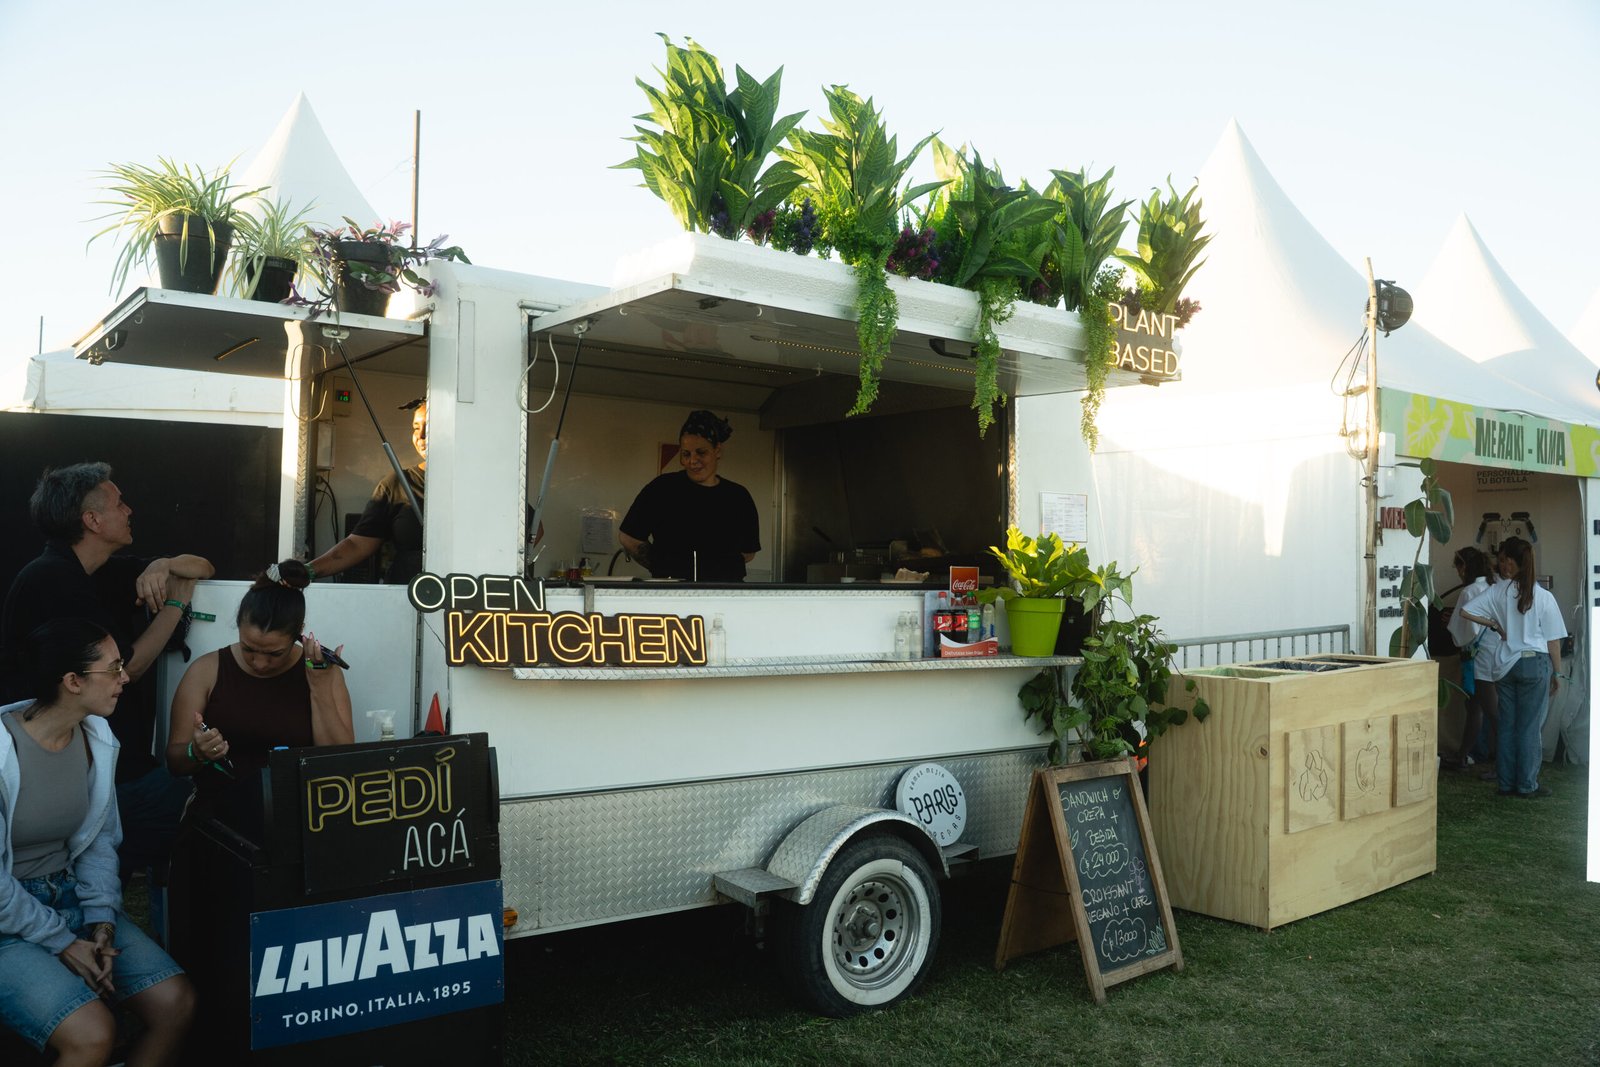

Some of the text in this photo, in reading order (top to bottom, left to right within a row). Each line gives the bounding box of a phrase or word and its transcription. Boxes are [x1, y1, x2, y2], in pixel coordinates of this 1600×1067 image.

[1106, 302, 1180, 339] PLANT
[1105, 341, 1179, 375] BASED
[1475, 417, 1524, 462] MERAKI
[1536, 427, 1566, 467] KIMA
[1477, 476, 1528, 485] TU BOTELLA
[412, 574, 544, 611] OPEN
[449, 612, 706, 663] KITCHEN
[307, 747, 456, 832] PEDÍ
[909, 784, 958, 825] PARIS
[1060, 787, 1108, 811] SANDWICH
[1110, 809, 1119, 824] +
[403, 807, 470, 871] ACÁ
[1082, 880, 1134, 907] CROISSANT
[1122, 902, 1130, 917] +
[254, 909, 500, 998] LAVAZZA
[433, 981, 471, 999] 1895
